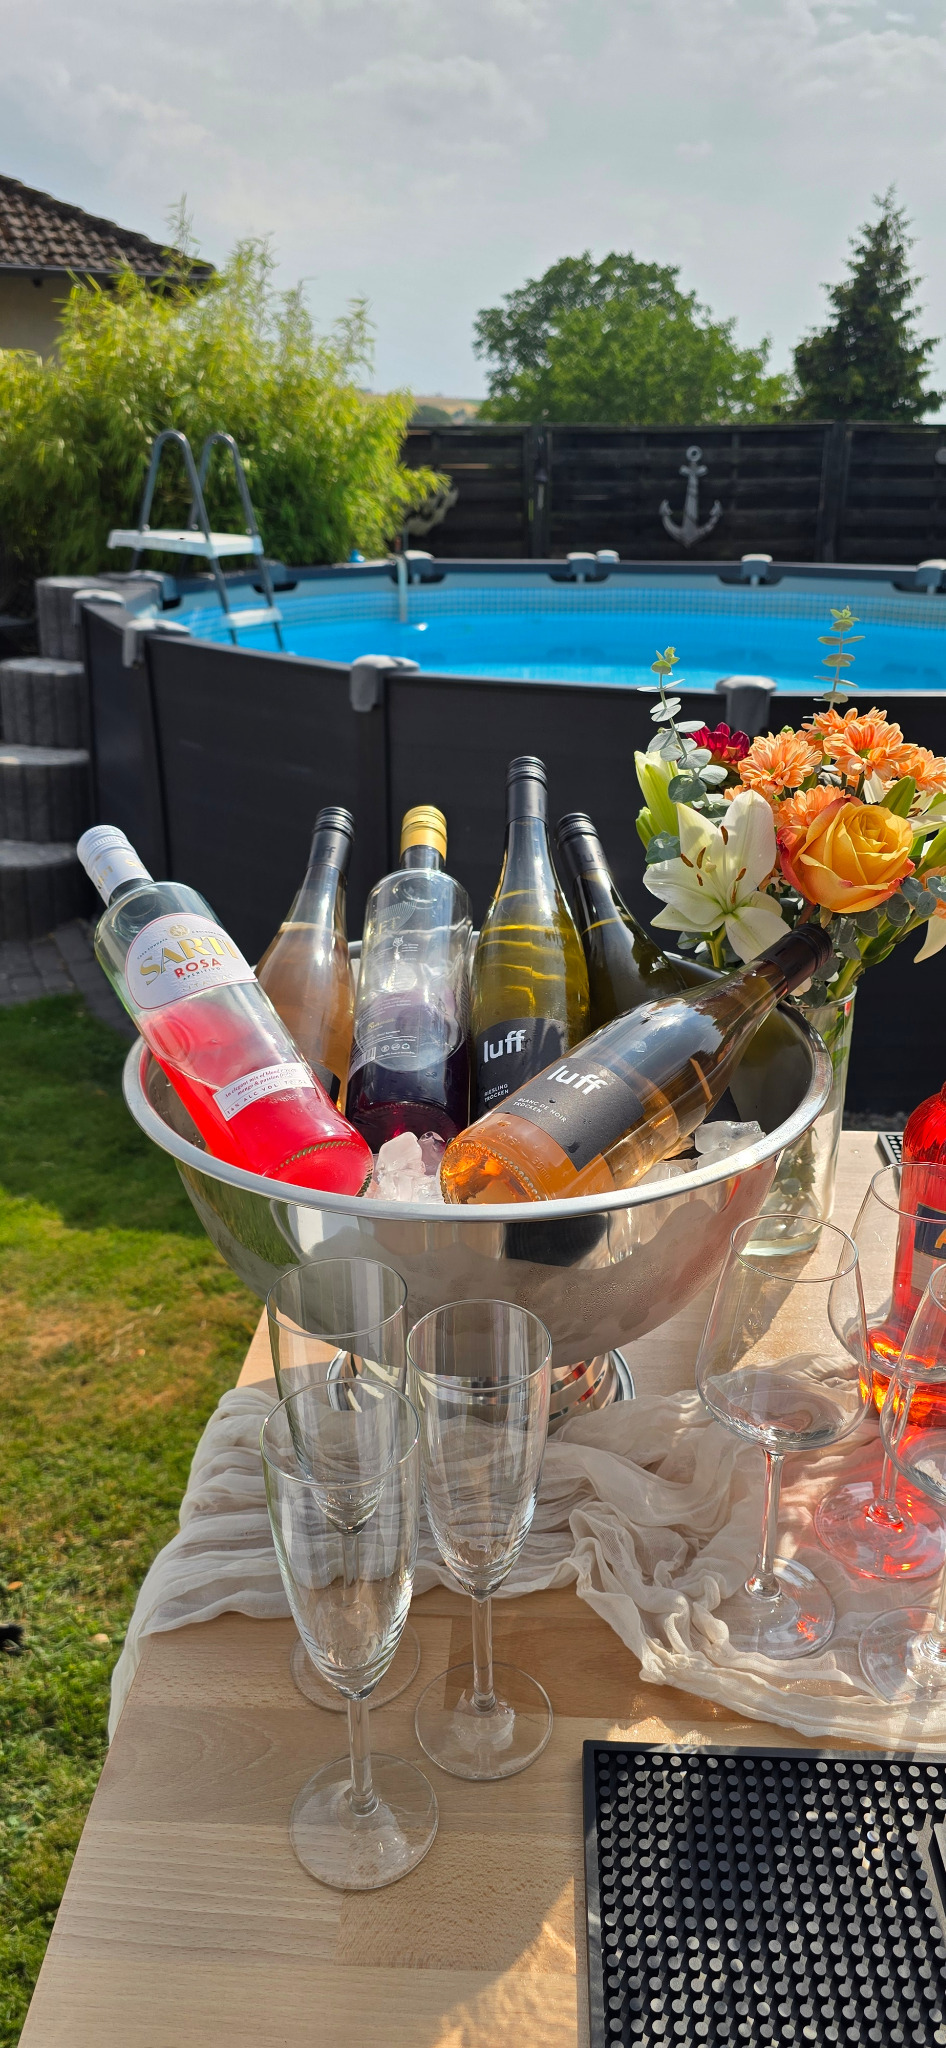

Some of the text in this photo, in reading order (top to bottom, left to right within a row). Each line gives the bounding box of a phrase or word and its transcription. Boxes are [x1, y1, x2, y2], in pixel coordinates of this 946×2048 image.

[140, 936, 239, 986] SARTI
[174, 958, 222, 979] ROSA
[483, 1029, 527, 1063] luff
[484, 1083, 509, 1097] RIESLING
[547, 1065, 609, 1096] luff
[243, 1091, 259, 1102] ALC
[261, 1083, 279, 1092] VOL
[484, 1089, 509, 1102] TROCKEN
[513, 1101, 542, 1113] TROCKEN
[539, 1103, 549, 1111] DE
[550, 1110, 567, 1123] NOIR
